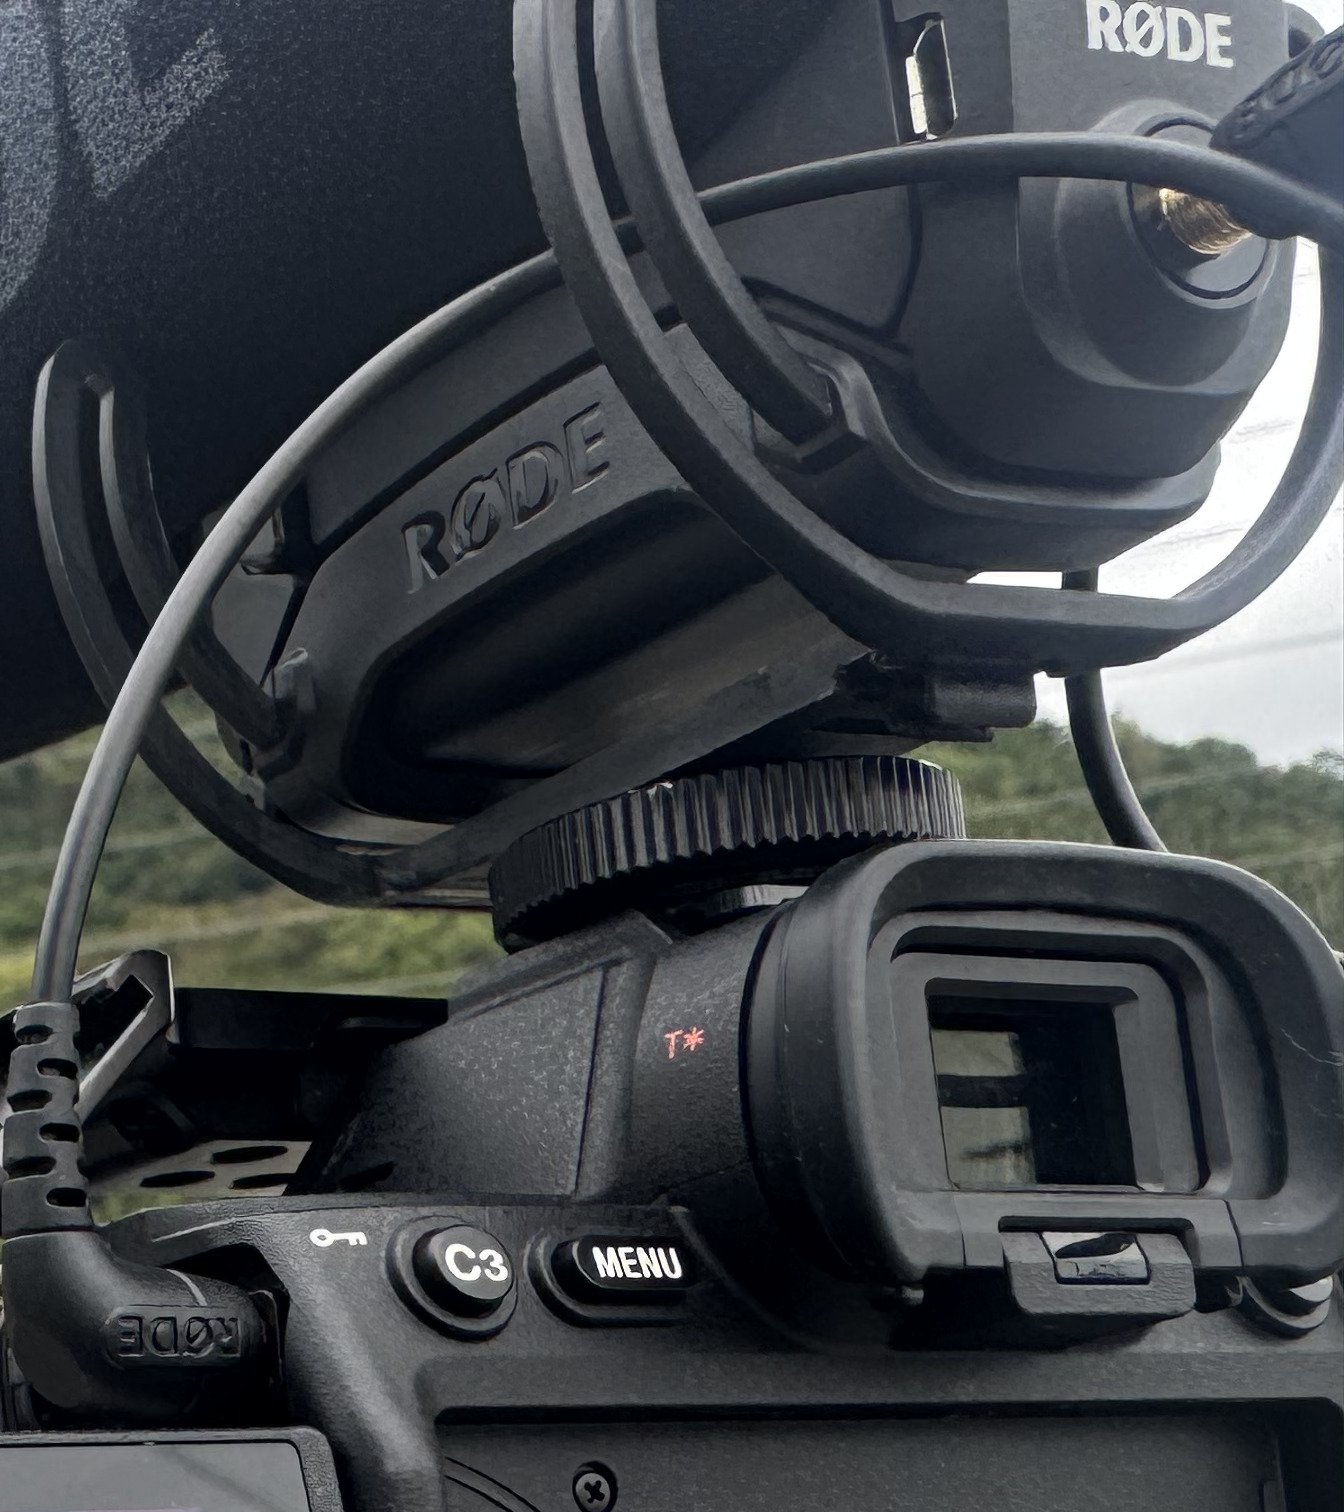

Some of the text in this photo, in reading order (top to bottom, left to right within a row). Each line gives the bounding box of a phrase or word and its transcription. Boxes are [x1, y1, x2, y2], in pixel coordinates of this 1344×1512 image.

[1086, 0, 1234, 68] RØDE
[401, 401, 611, 594] RØDE
[445, 1243, 508, 1282] C3
[592, 1246, 683, 1279] MENU
